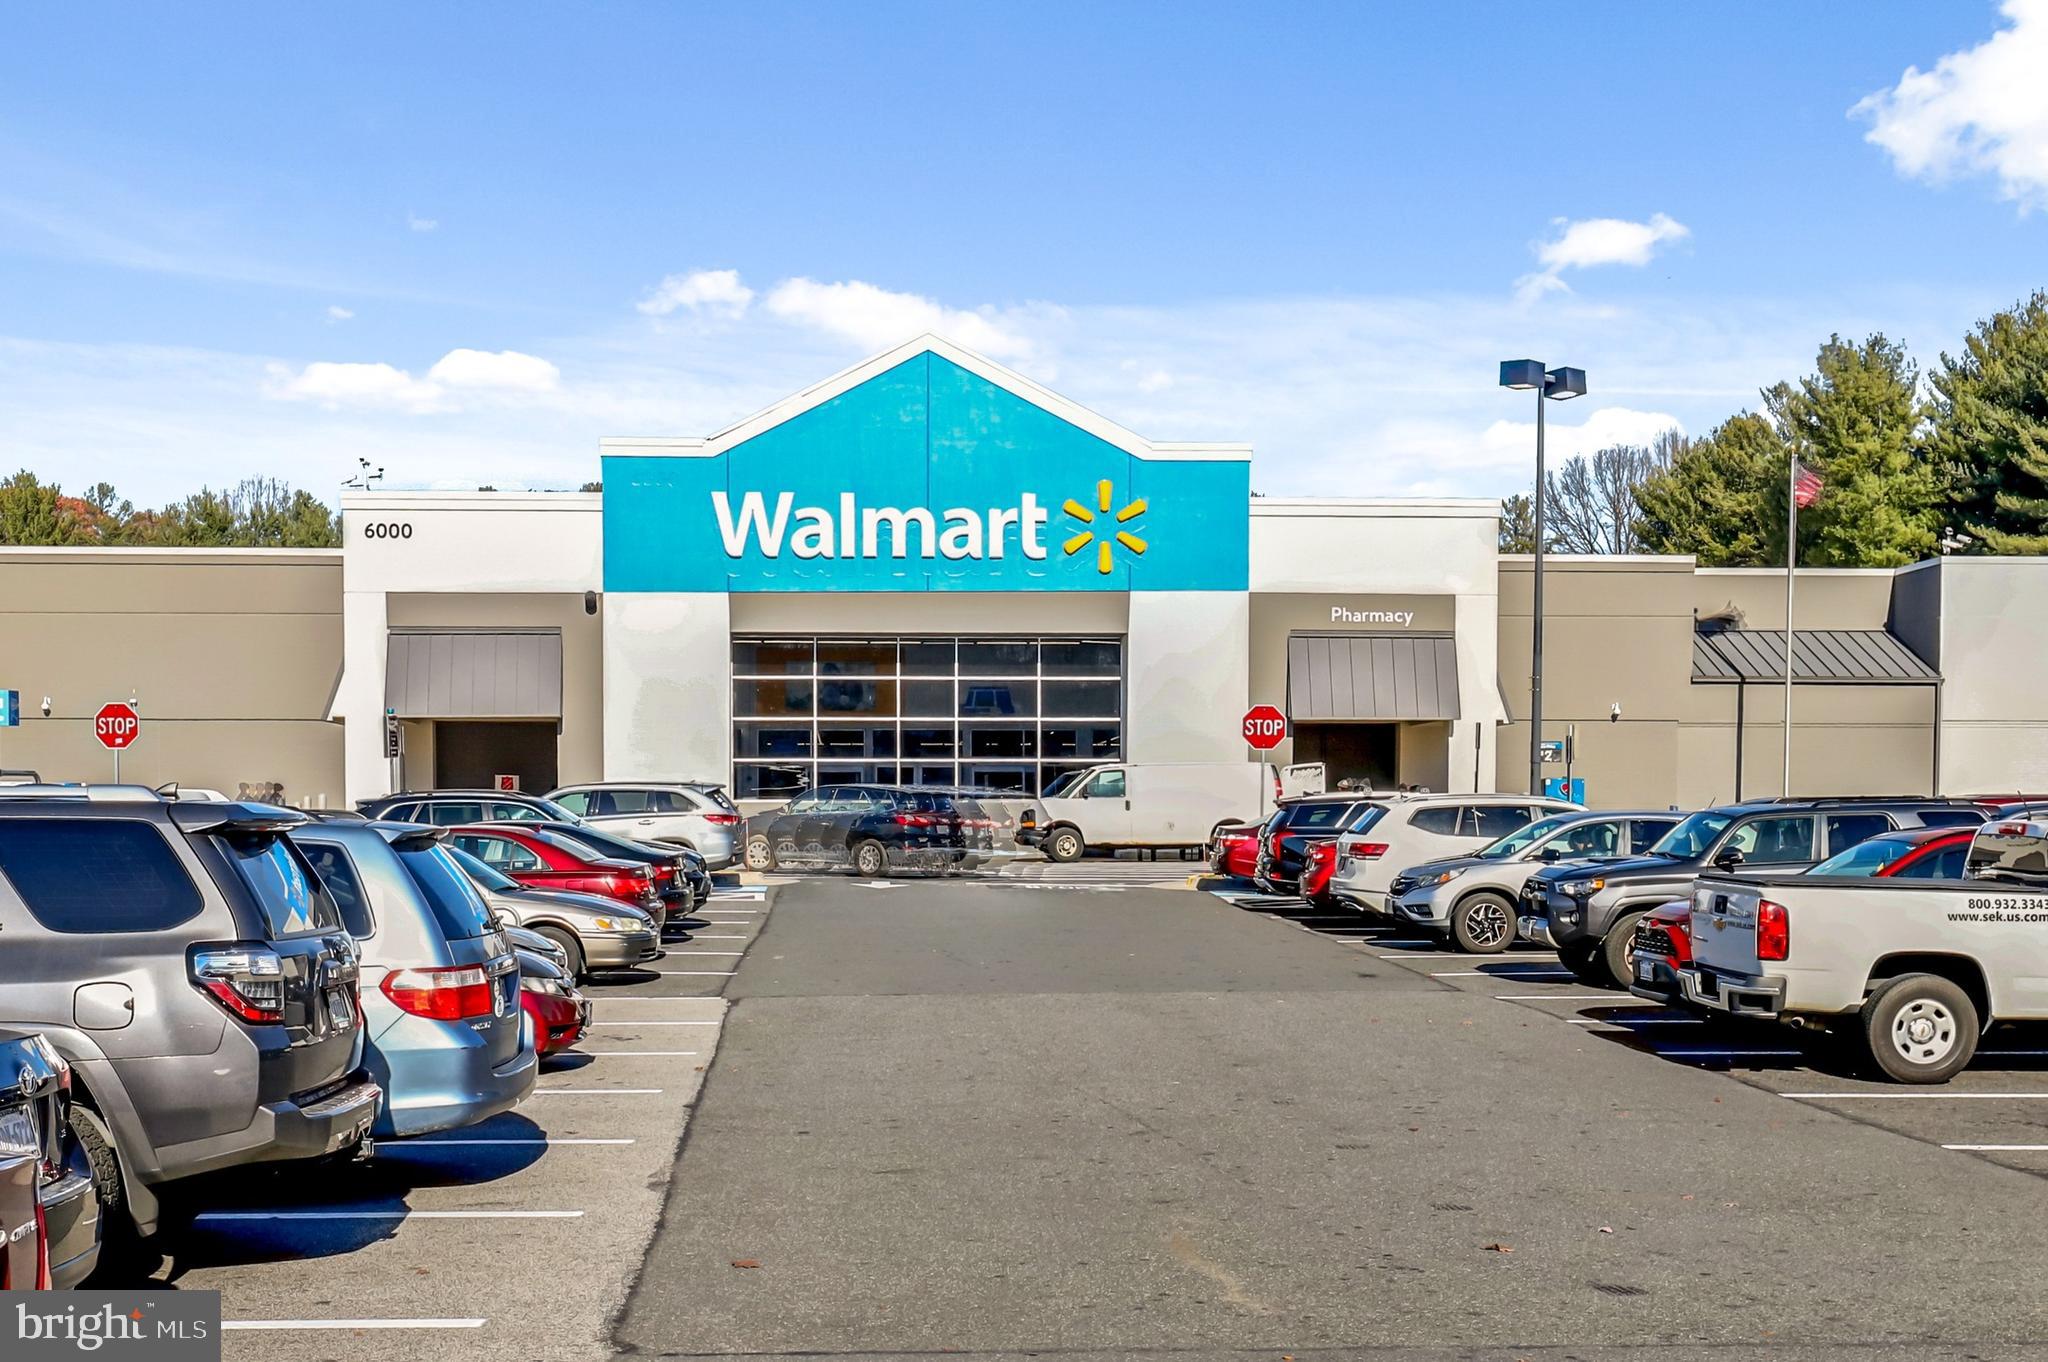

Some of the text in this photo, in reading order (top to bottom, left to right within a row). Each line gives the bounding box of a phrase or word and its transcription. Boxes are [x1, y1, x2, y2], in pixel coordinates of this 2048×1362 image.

[365, 523, 412, 539] 6000
[711, 491, 1047, 560] Walmart
[1331, 607, 1414, 627] Pharmacy
[98, 717, 135, 734] STOP
[1245, 719, 1283, 736] STOP
[1968, 898, 2048, 909] 800.932.3343
[1947, 911, 2048, 922] www.sek.us.com
